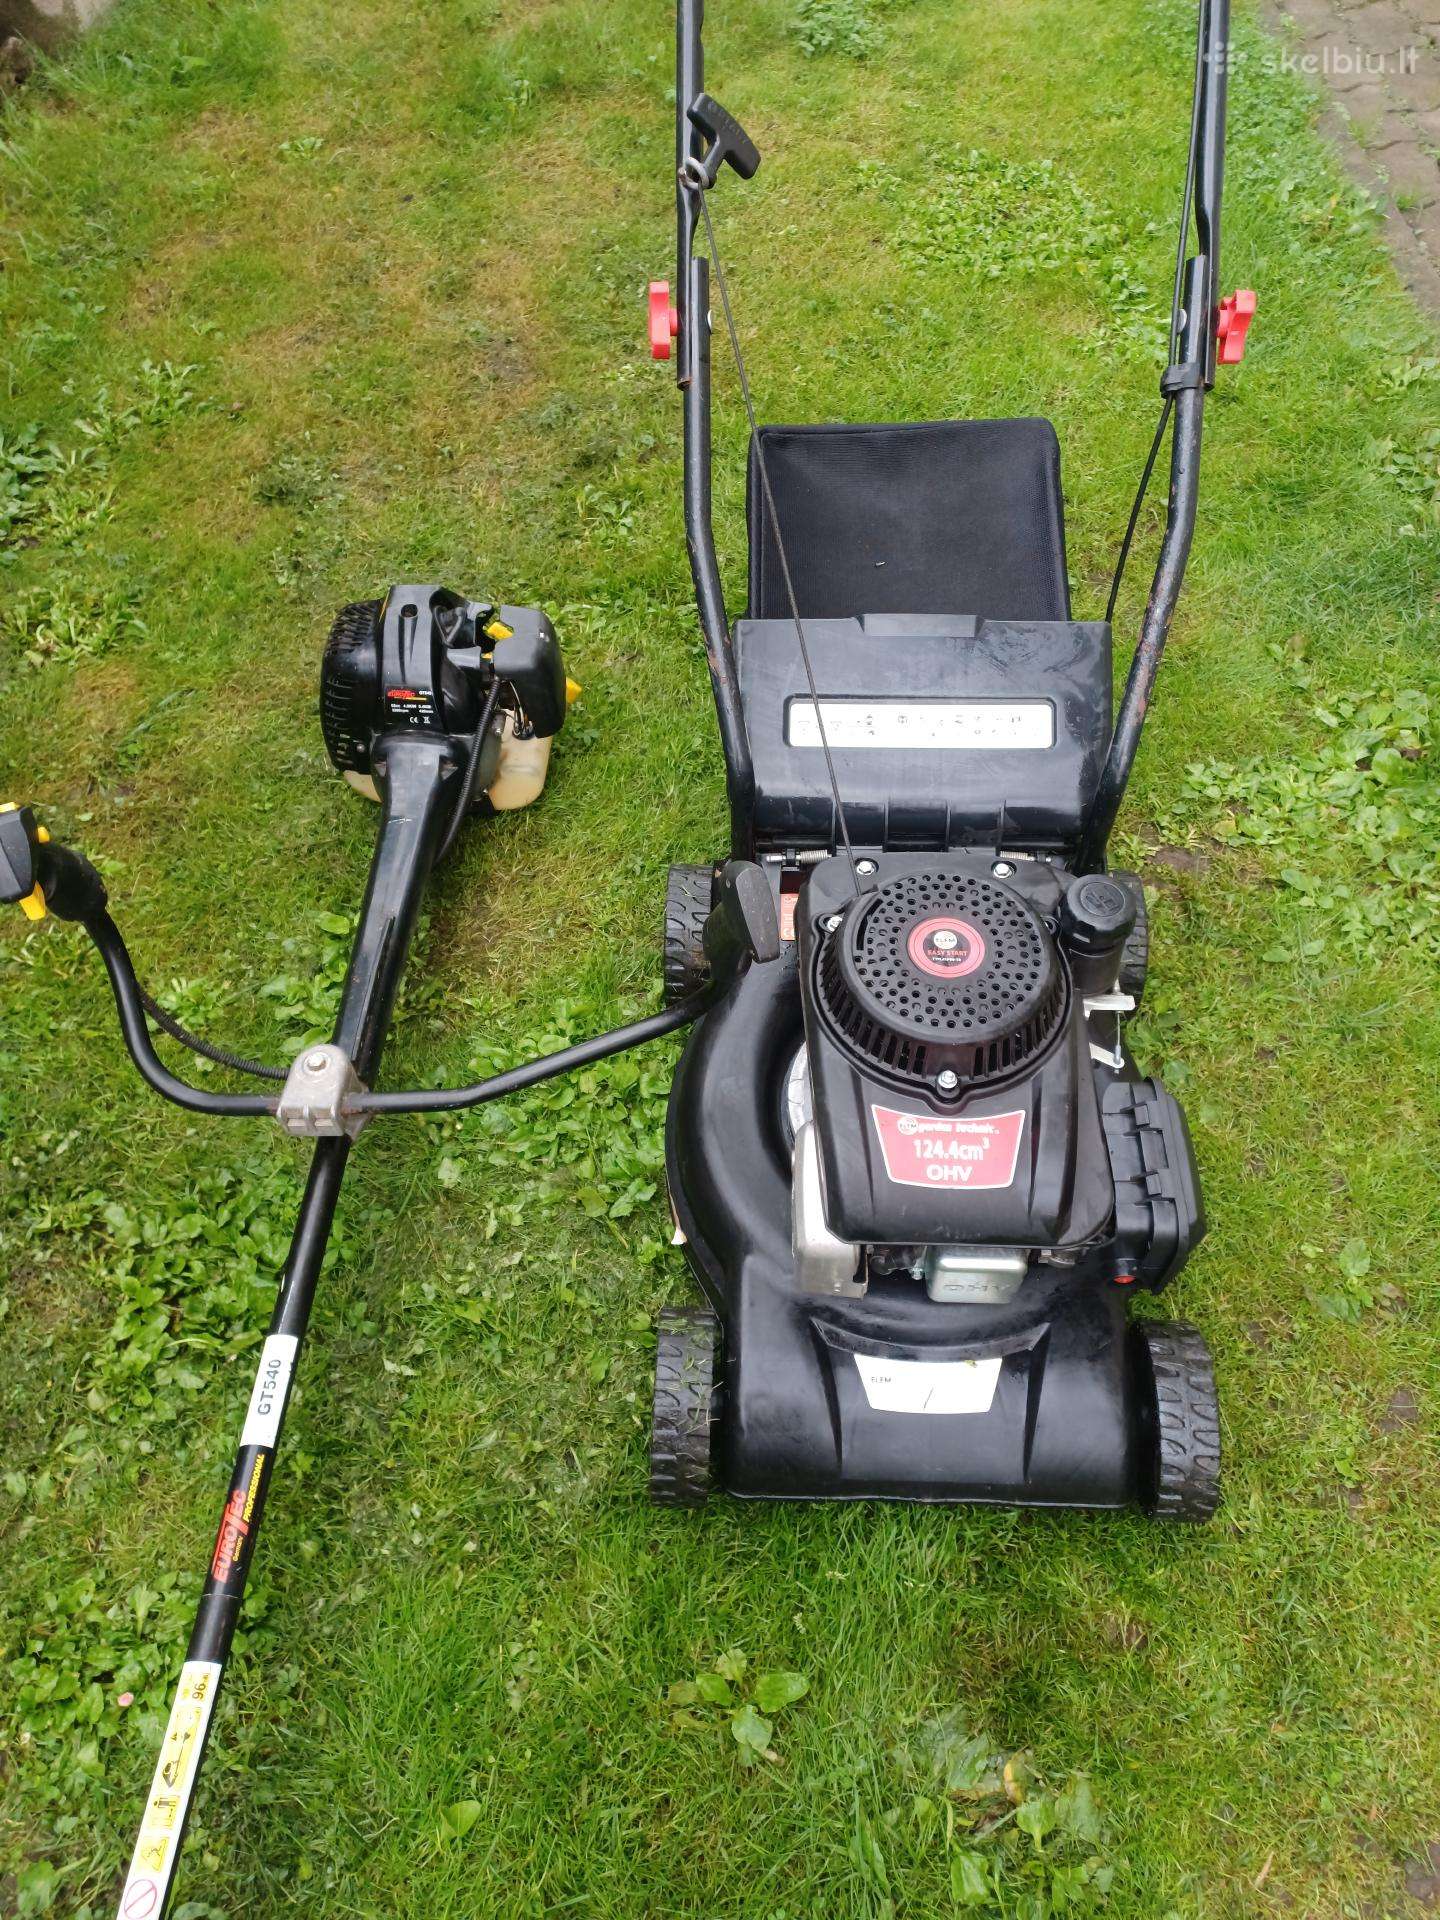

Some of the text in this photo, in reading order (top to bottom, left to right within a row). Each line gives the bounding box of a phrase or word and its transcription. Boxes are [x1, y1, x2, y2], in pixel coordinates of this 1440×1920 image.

[926, 1164, 973, 1182] OHV
[257, 1358, 282, 1416] GT540
[242, 1453, 265, 1524] PROFESSIONAL
[232, 1534, 244, 1562] Germany
[191, 1681, 207, 1701] 96
